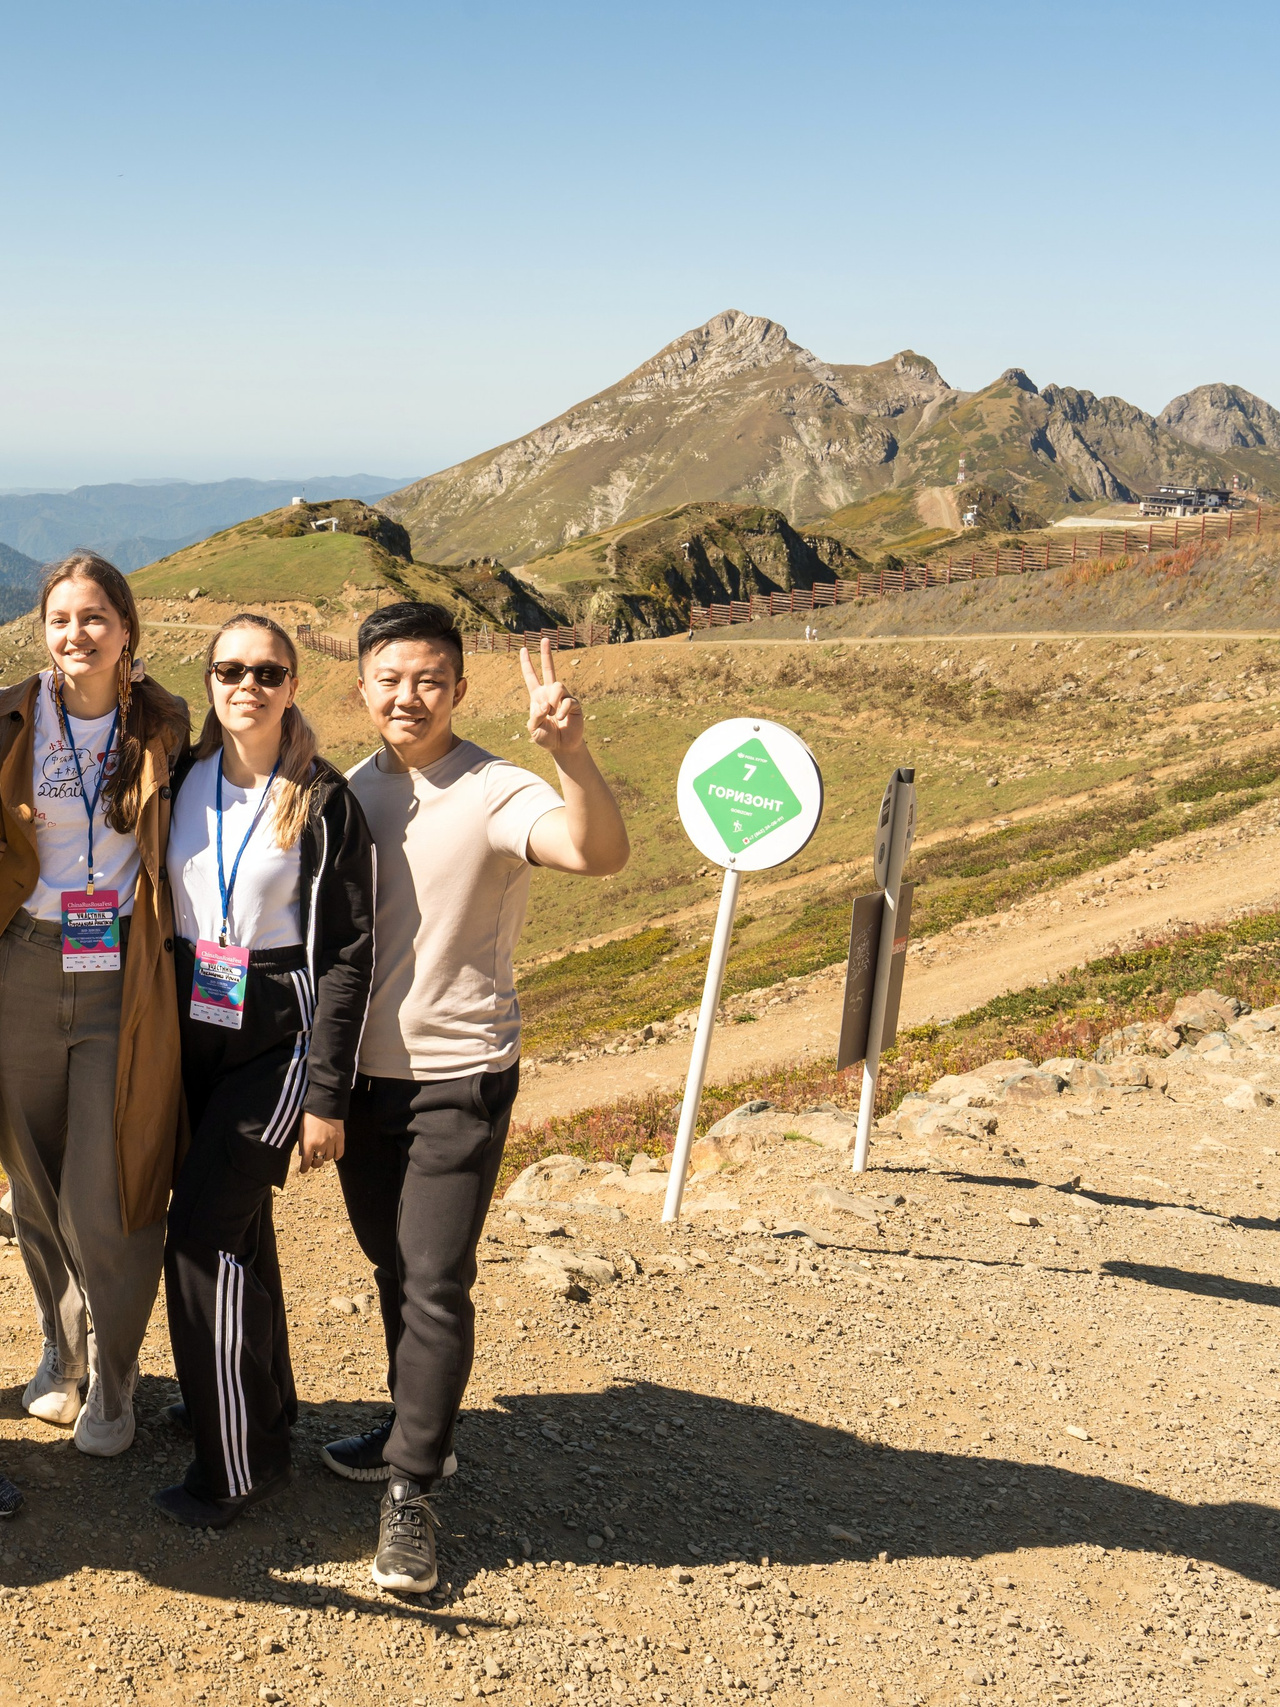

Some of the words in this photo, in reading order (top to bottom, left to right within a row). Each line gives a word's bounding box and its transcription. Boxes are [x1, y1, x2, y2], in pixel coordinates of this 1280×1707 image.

[743, 763, 757, 781] 7
[37, 782, 84, 799] Давай
[708, 784, 784, 812] ГОРИЗОНТ
